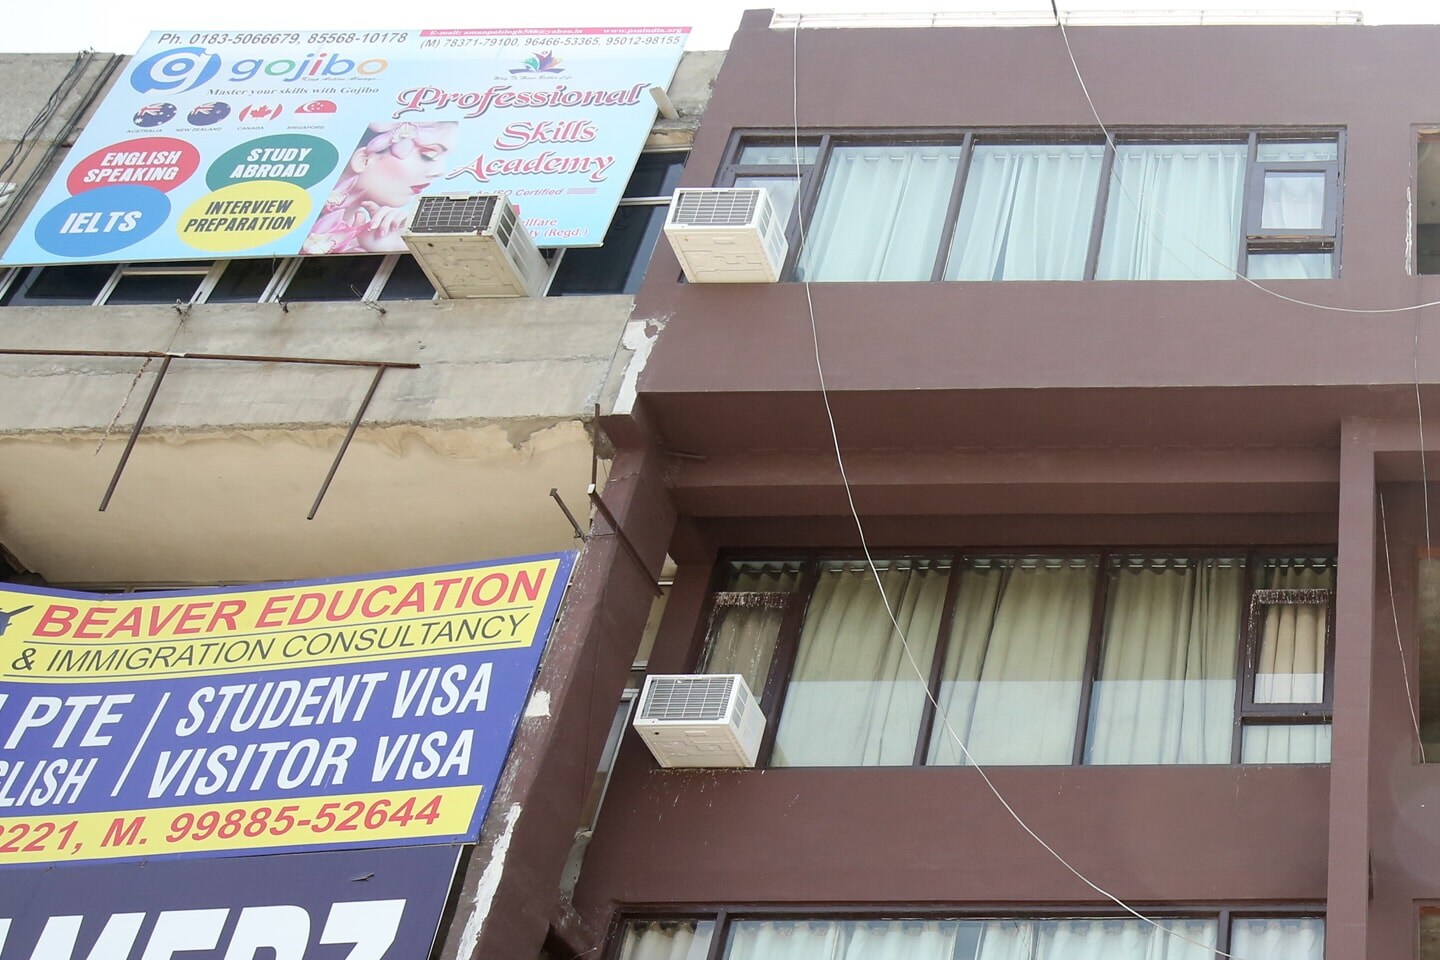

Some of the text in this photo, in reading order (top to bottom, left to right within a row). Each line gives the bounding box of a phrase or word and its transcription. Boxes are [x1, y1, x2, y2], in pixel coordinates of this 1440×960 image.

[157, 32, 408, 45] Ph. 0183-5066679, 85568-10178
[420, 36, 681, 49] (M) 78371-79100, 96466-53365, 95012-98155
[228, 53, 388, 82] gojibo
[207, 88, 249, 96] Master
[249, 88, 277, 96] your
[392, 82, 652, 118] Professional
[493, 120, 598, 150] Skills
[100, 150, 182, 166] ENGLISH
[246, 148, 312, 162] STUDY
[83, 167, 180, 183] SPEAKING
[229, 164, 310, 178] ABROAD
[446, 151, 615, 182] Academy
[516, 188, 564, 196] Certified
[204, 199, 294, 215] INTERVIEW
[60, 210, 142, 234] IELTS
[184, 216, 296, 233] PREPARATION
[544, 228, 588, 238] (Regd.)
[33, 568, 548, 639] BEAVER EDUCATION
[11, 612, 531, 672] & IMMIGRATION CONSULTANCY
[4, 693, 135, 750] PTE
[175, 672, 389, 738] STUDENT
[392, 662, 494, 718] VISA
[148, 729, 475, 799] VISITOR VISA
[101, 816, 147, 848] M.
[166, 795, 441, 843] 99885-52644
